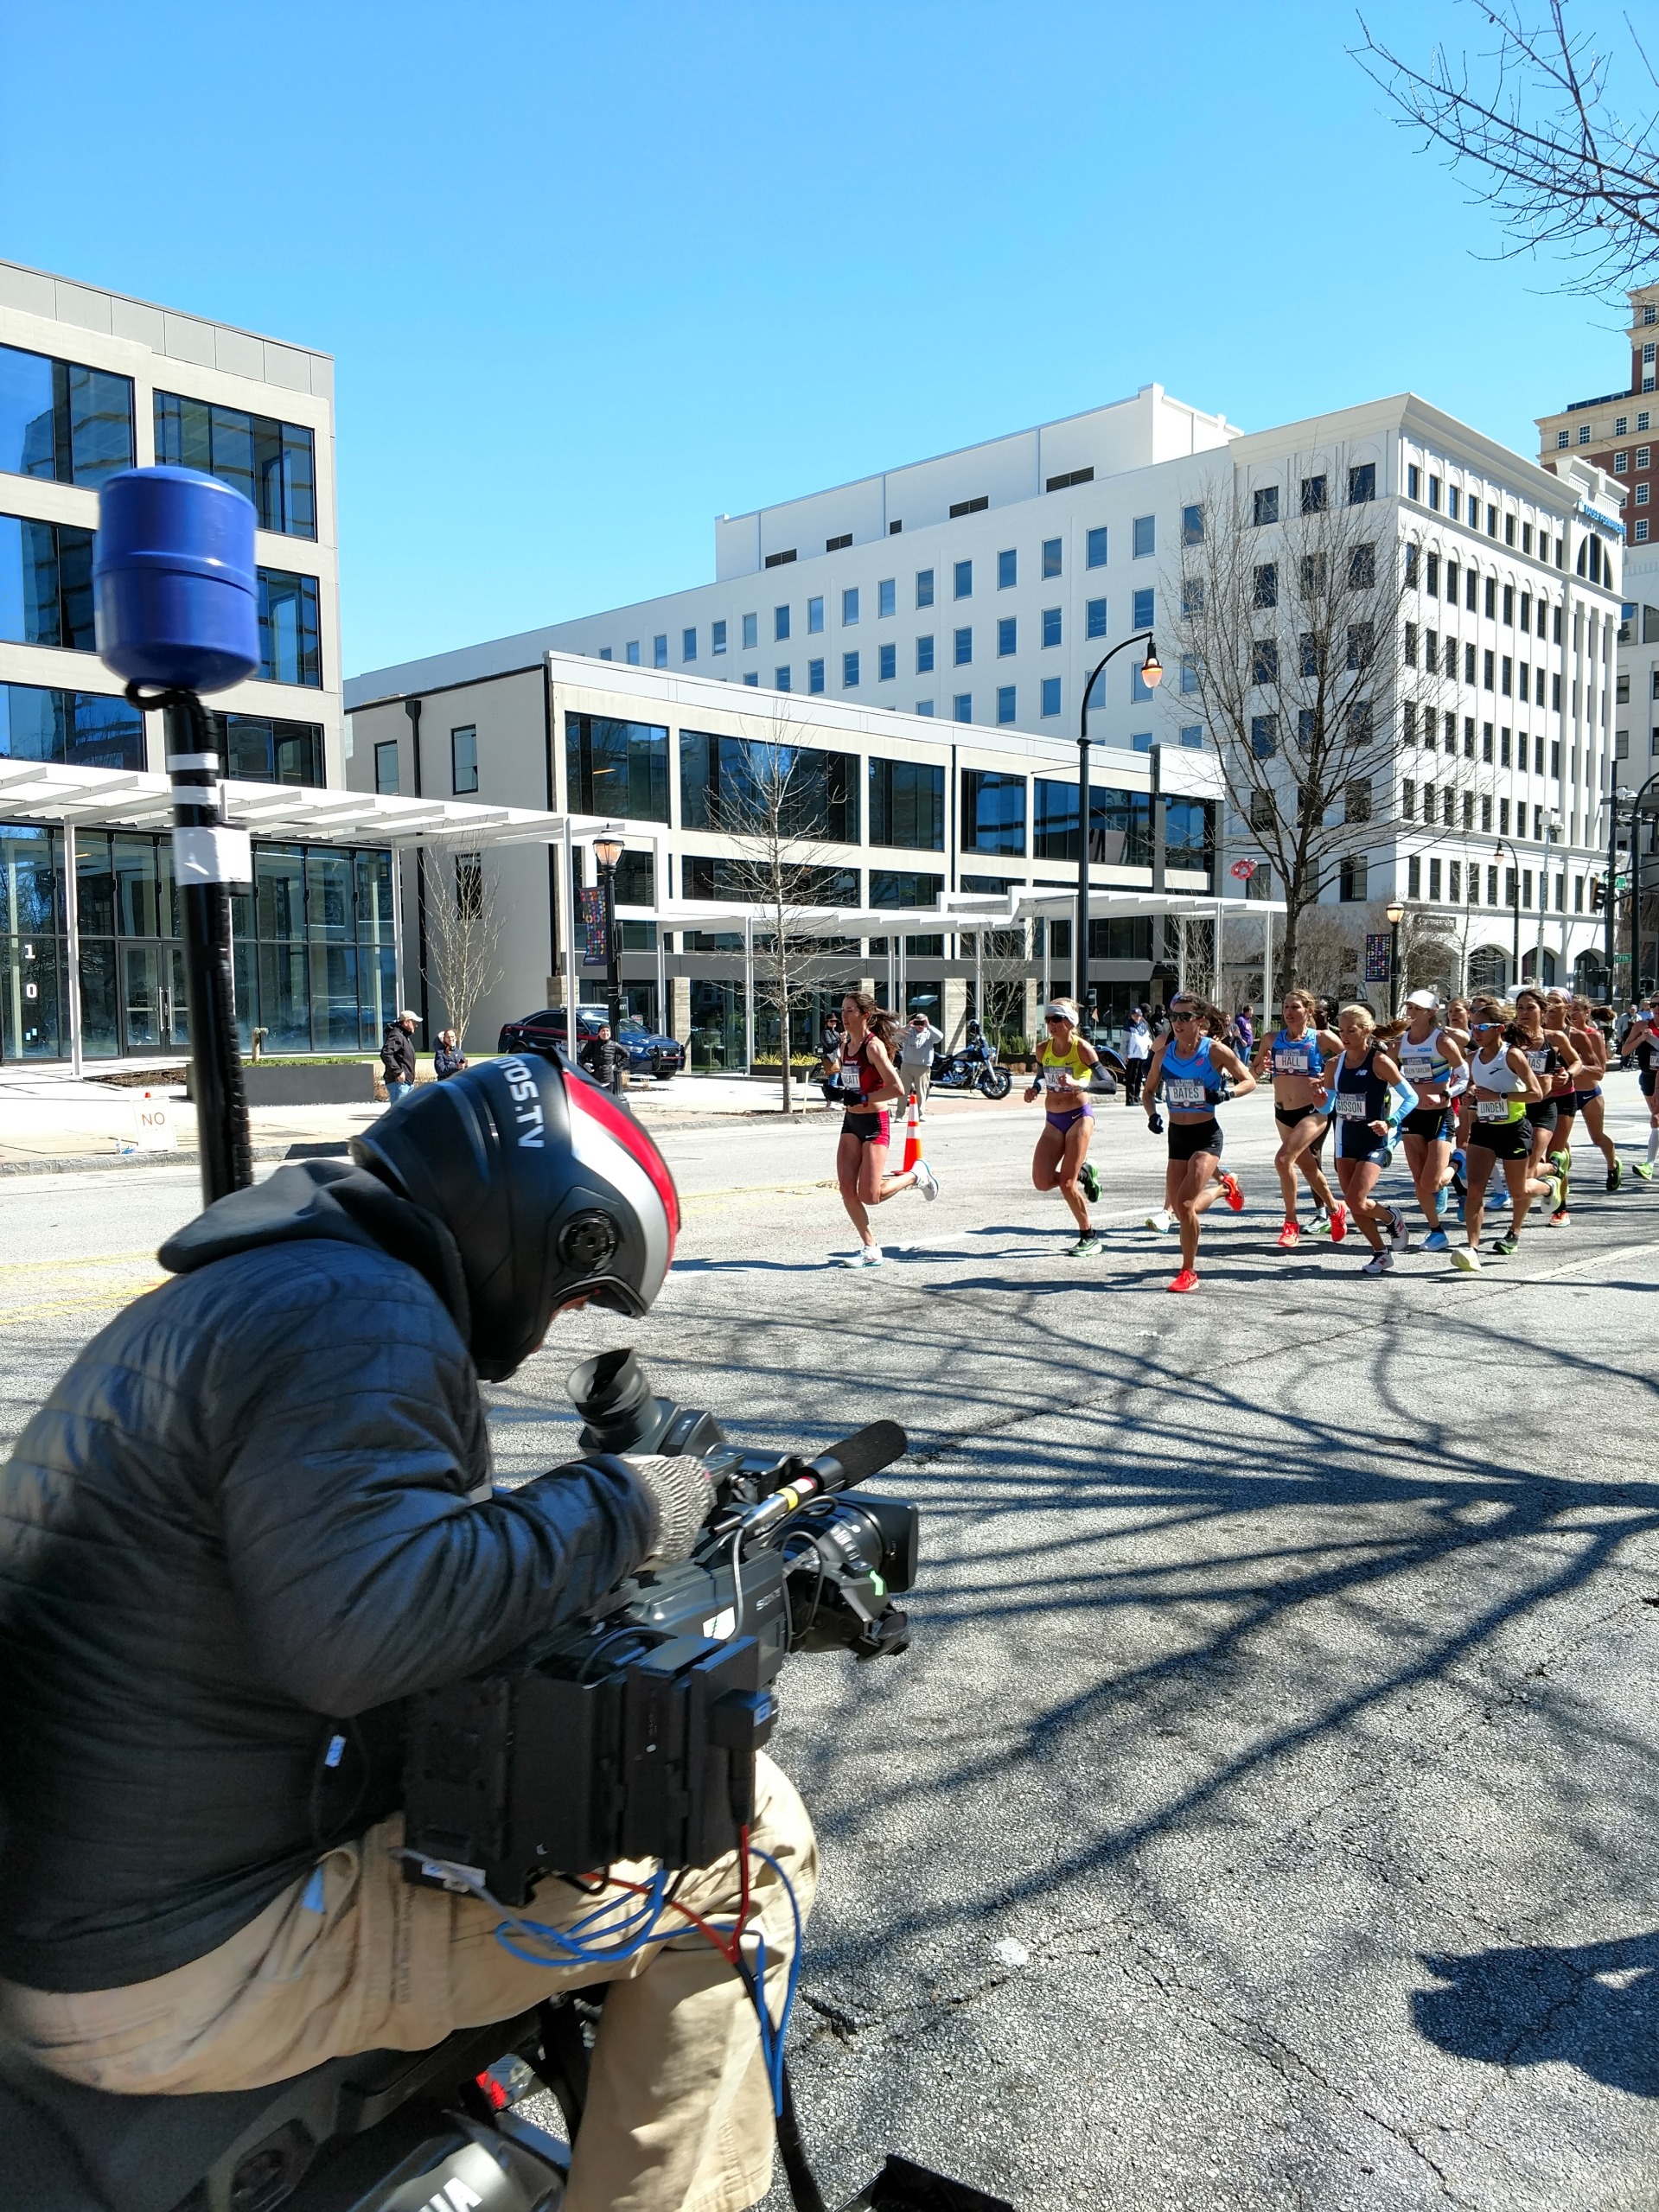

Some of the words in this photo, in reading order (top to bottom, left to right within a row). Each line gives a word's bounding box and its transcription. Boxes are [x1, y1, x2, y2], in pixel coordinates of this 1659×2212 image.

[1281, 1056, 1301, 1067] HALL
[1172, 1087, 1199, 1100] BATES
[1337, 1100, 1362, 1113] SISSON
[1480, 1101, 1504, 1113] LINDEN
[141, 1112, 165, 1126] NO
